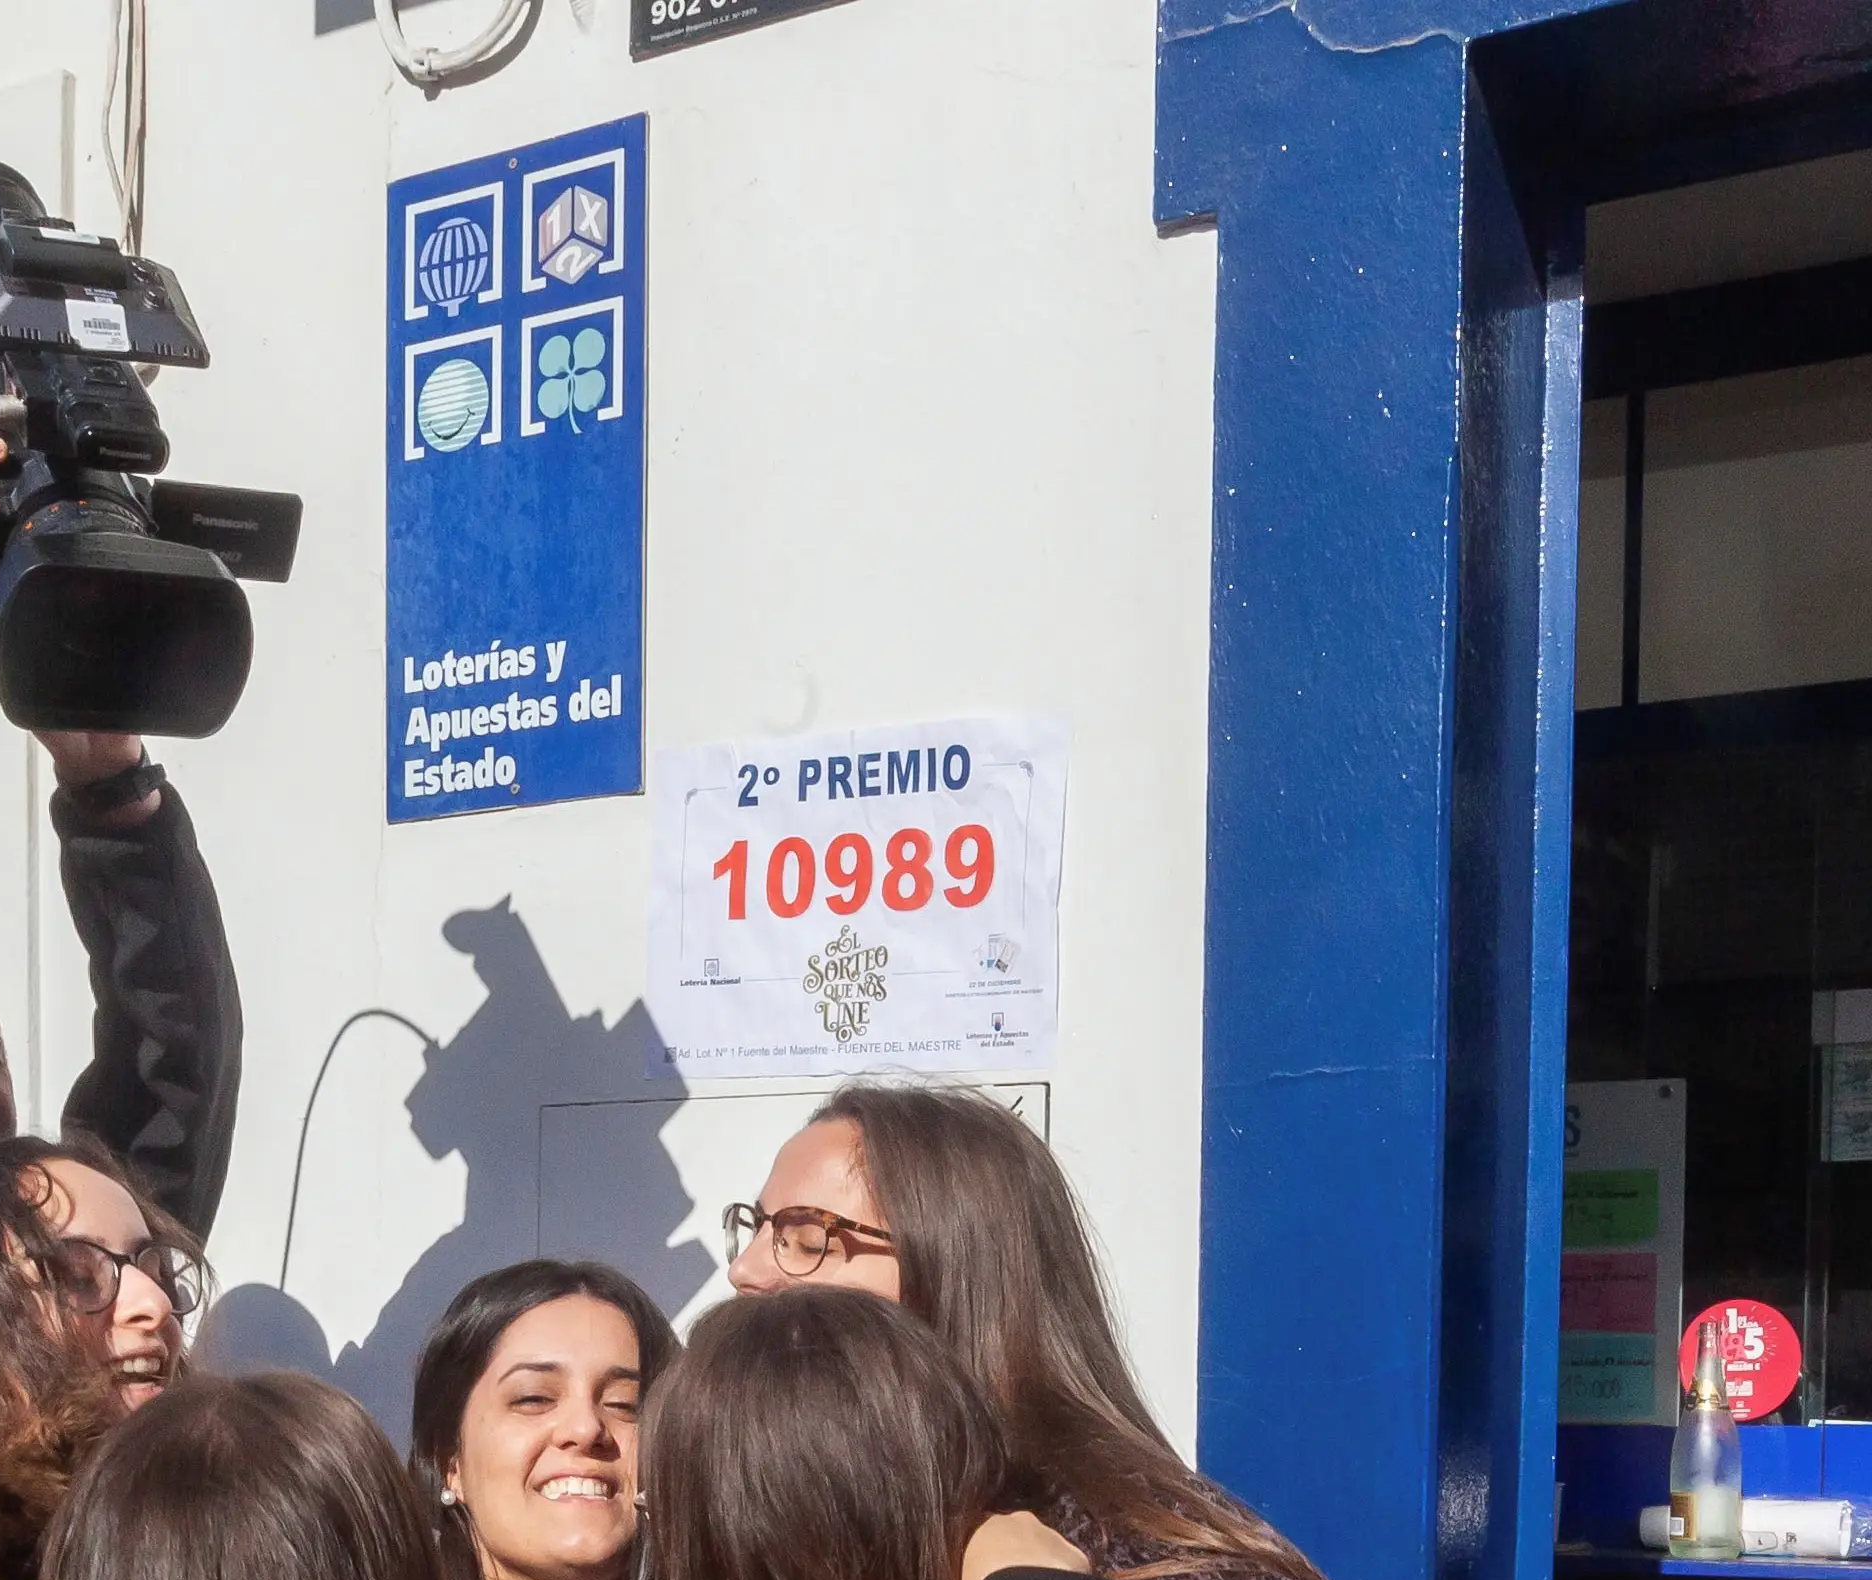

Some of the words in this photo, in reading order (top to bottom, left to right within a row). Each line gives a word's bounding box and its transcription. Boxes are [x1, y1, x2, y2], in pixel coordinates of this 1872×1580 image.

[99, 446, 152, 461] Panasonic
[192, 513, 259, 530] Panasonic
[404, 640, 536, 694] Loterías
[545, 640, 567, 683] y
[405, 692, 558, 752] Apuestas
[568, 674, 622, 722] del
[404, 747, 517, 797] Estado
[738, 764, 780, 807] 2º
[798, 744, 971, 802] PREMIO
[713, 824, 995, 920] 10989
[710, 976, 741, 986] Nacional
[738, 1046, 770, 1057] Fuente
[773, 1045, 786, 1056] del
[790, 1044, 828, 1055] Maestre
[838, 1042, 881, 1054] FUENTE
[884, 1041, 904, 1053] DEL
[908, 1040, 962, 1052] MAESTRE
